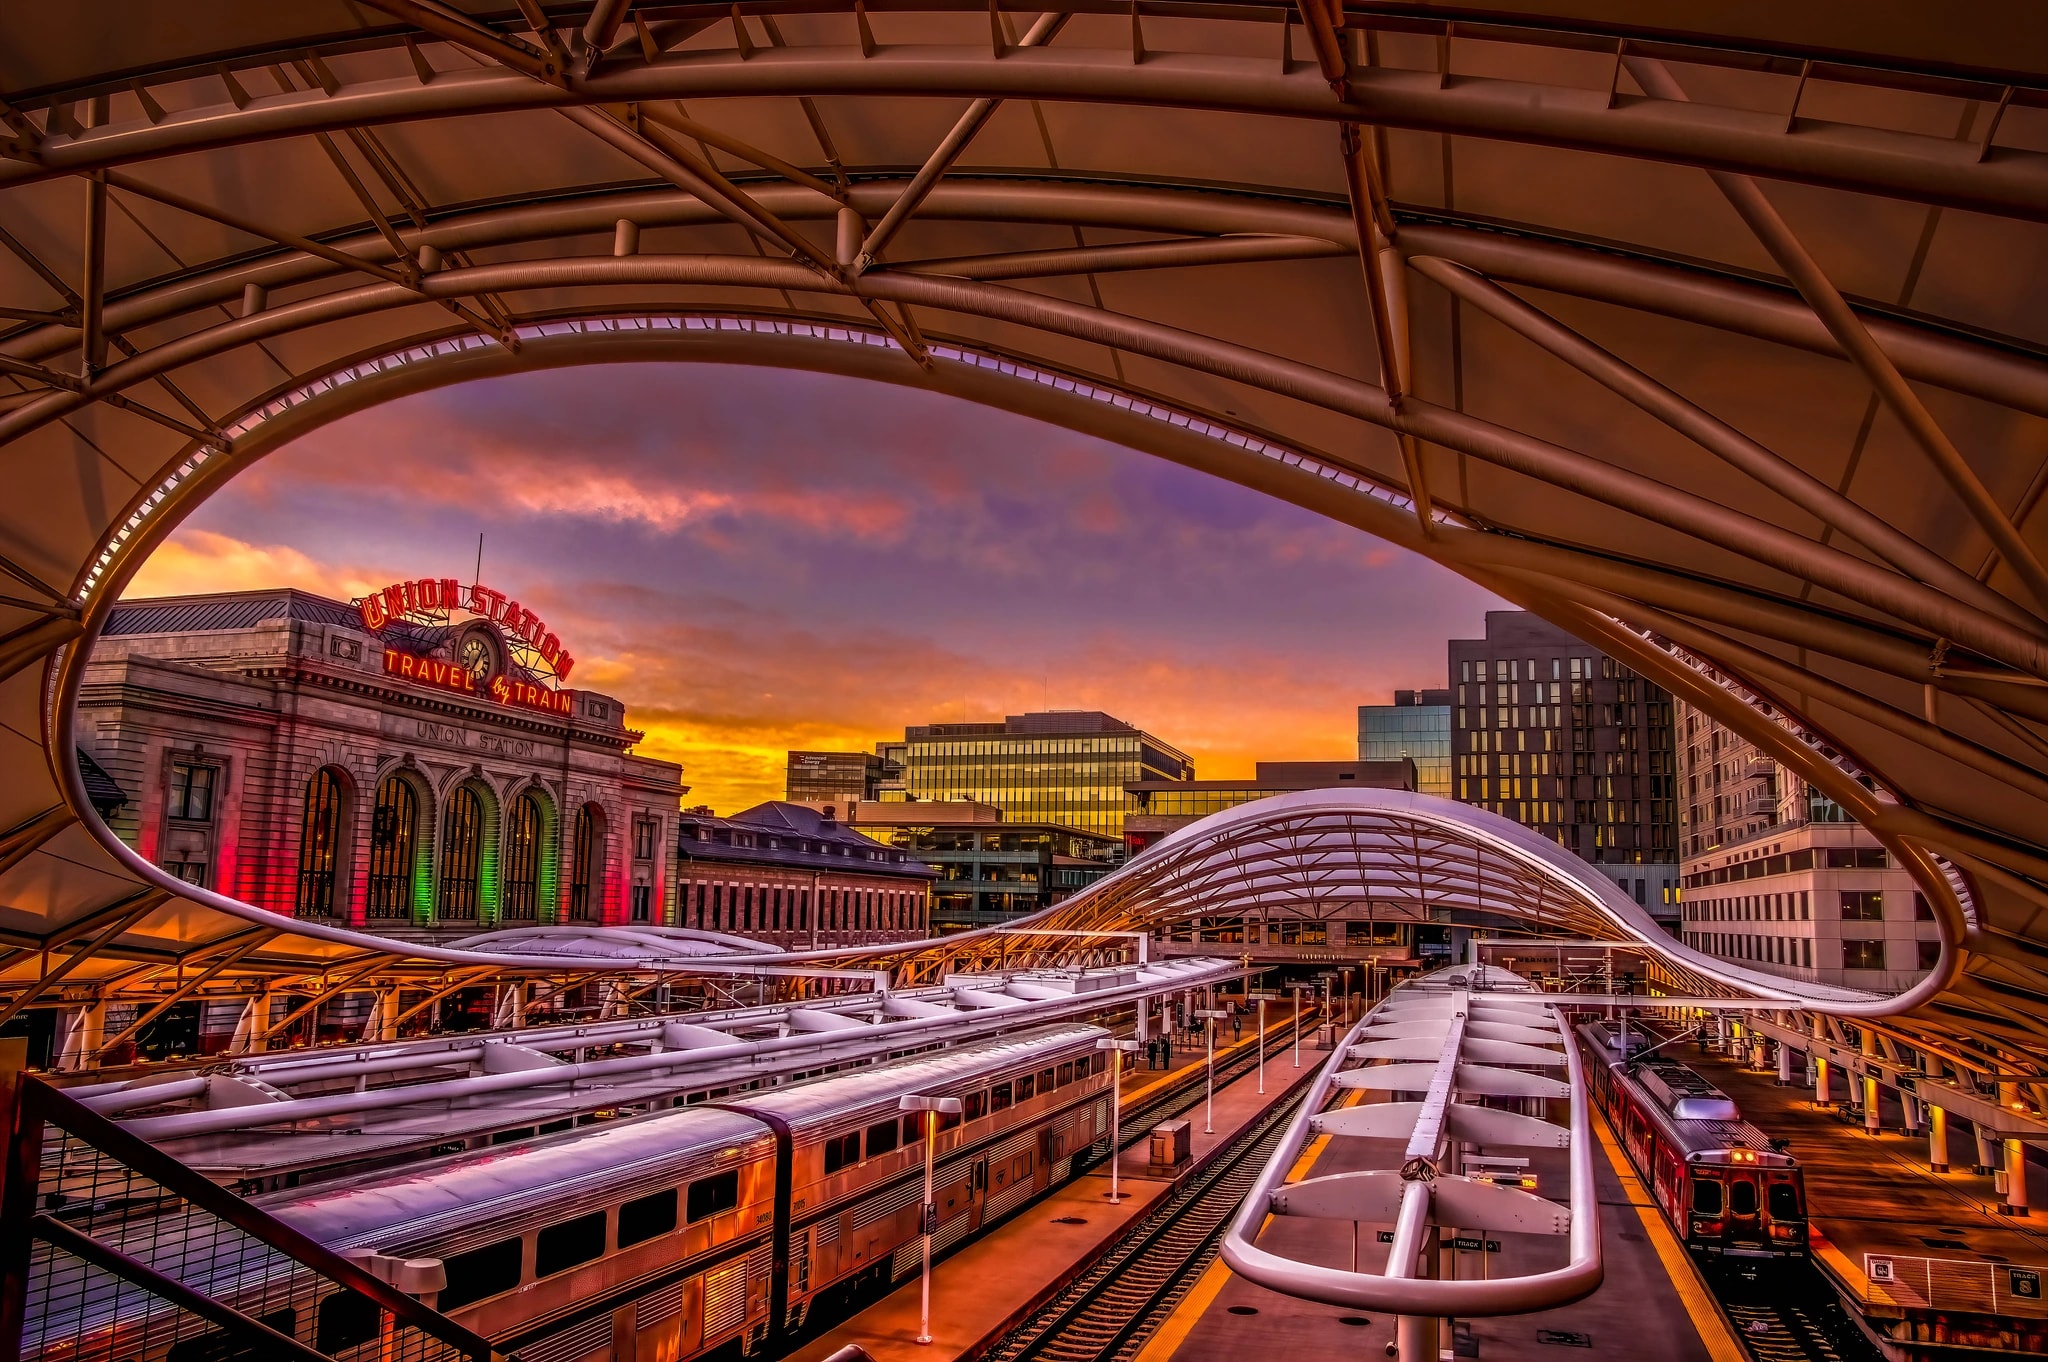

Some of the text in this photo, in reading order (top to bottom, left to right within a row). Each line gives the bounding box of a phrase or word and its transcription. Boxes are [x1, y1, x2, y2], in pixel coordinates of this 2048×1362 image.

[361, 578, 575, 682] UNION STATION
[385, 650, 571, 713] TRAVEL by TRAIN
[417, 721, 535, 757] UNION STATION
[1457, 1240, 1479, 1248] TRACK
[2012, 1272, 2037, 1280] TRACK
[2019, 1280, 2032, 1293] 8
